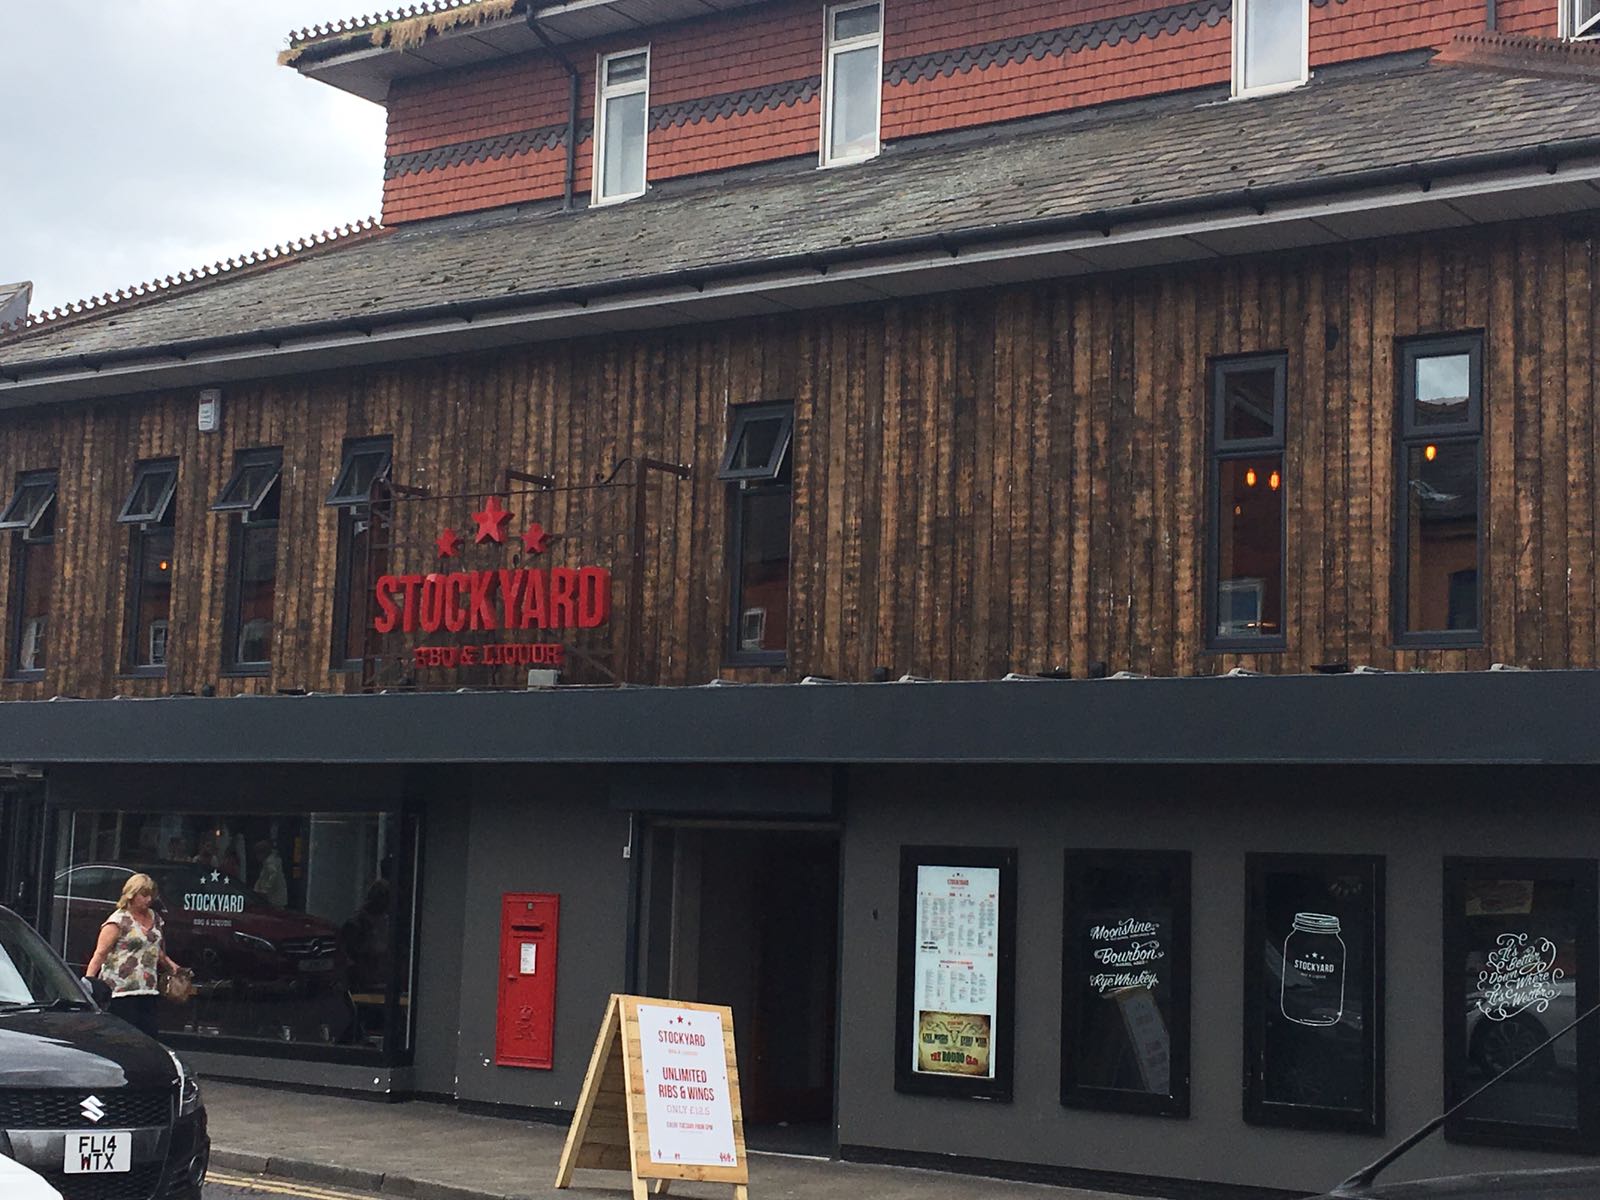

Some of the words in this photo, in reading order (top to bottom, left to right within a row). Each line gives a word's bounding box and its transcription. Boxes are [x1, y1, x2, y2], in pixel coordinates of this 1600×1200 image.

[374, 566, 611, 634] STOCKYARD
[459, 645, 478, 666] &
[481, 643, 565, 666] LIQUOR
[183, 893, 245, 913] STOCKYARD
[1090, 918, 1156, 940] Moonshine
[1096, 941, 1162, 965] Bourbon
[1294, 960, 1334, 973] STOCKYARD
[1093, 973, 1114, 992] Rye
[1114, 971, 1159, 990] Whiskey
[1488, 970, 1518, 984] Down
[1508, 972, 1550, 990] Where
[658, 1030, 706, 1047] STOCKYARD
[662, 1067, 707, 1083] UNLIMITED
[658, 1084, 678, 1099] RIBS
[680, 1086, 686, 1099] &
[687, 1086, 715, 1101] WINGS
[666, 1104, 688, 1114] ONLY
[79, 1135, 117, 1153] FL14
[81, 1152, 114, 1171] WTX
